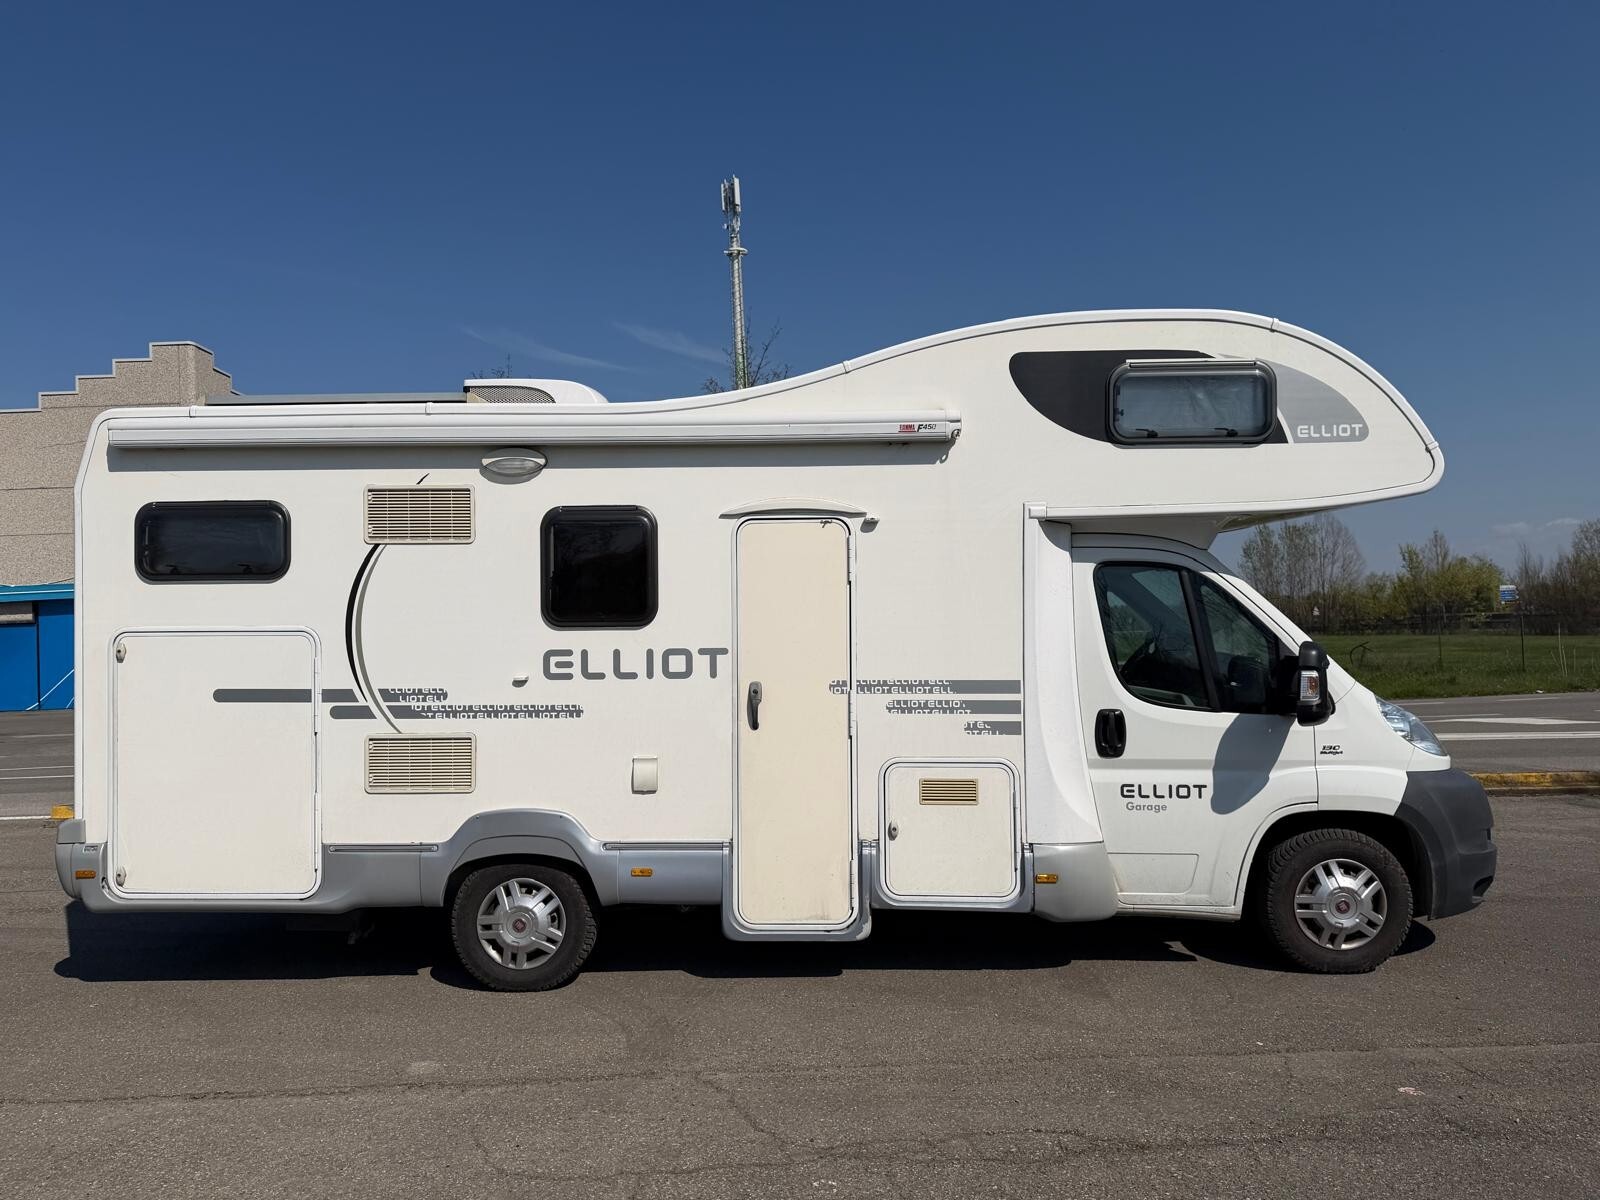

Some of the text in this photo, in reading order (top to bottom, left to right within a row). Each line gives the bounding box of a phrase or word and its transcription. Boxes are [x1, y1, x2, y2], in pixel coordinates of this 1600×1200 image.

[1297, 424, 1363, 437] ELLIOT
[543, 648, 729, 680] ELLIOT
[1120, 784, 1207, 799] ELLIOT
[1126, 802, 1167, 813] Garage
